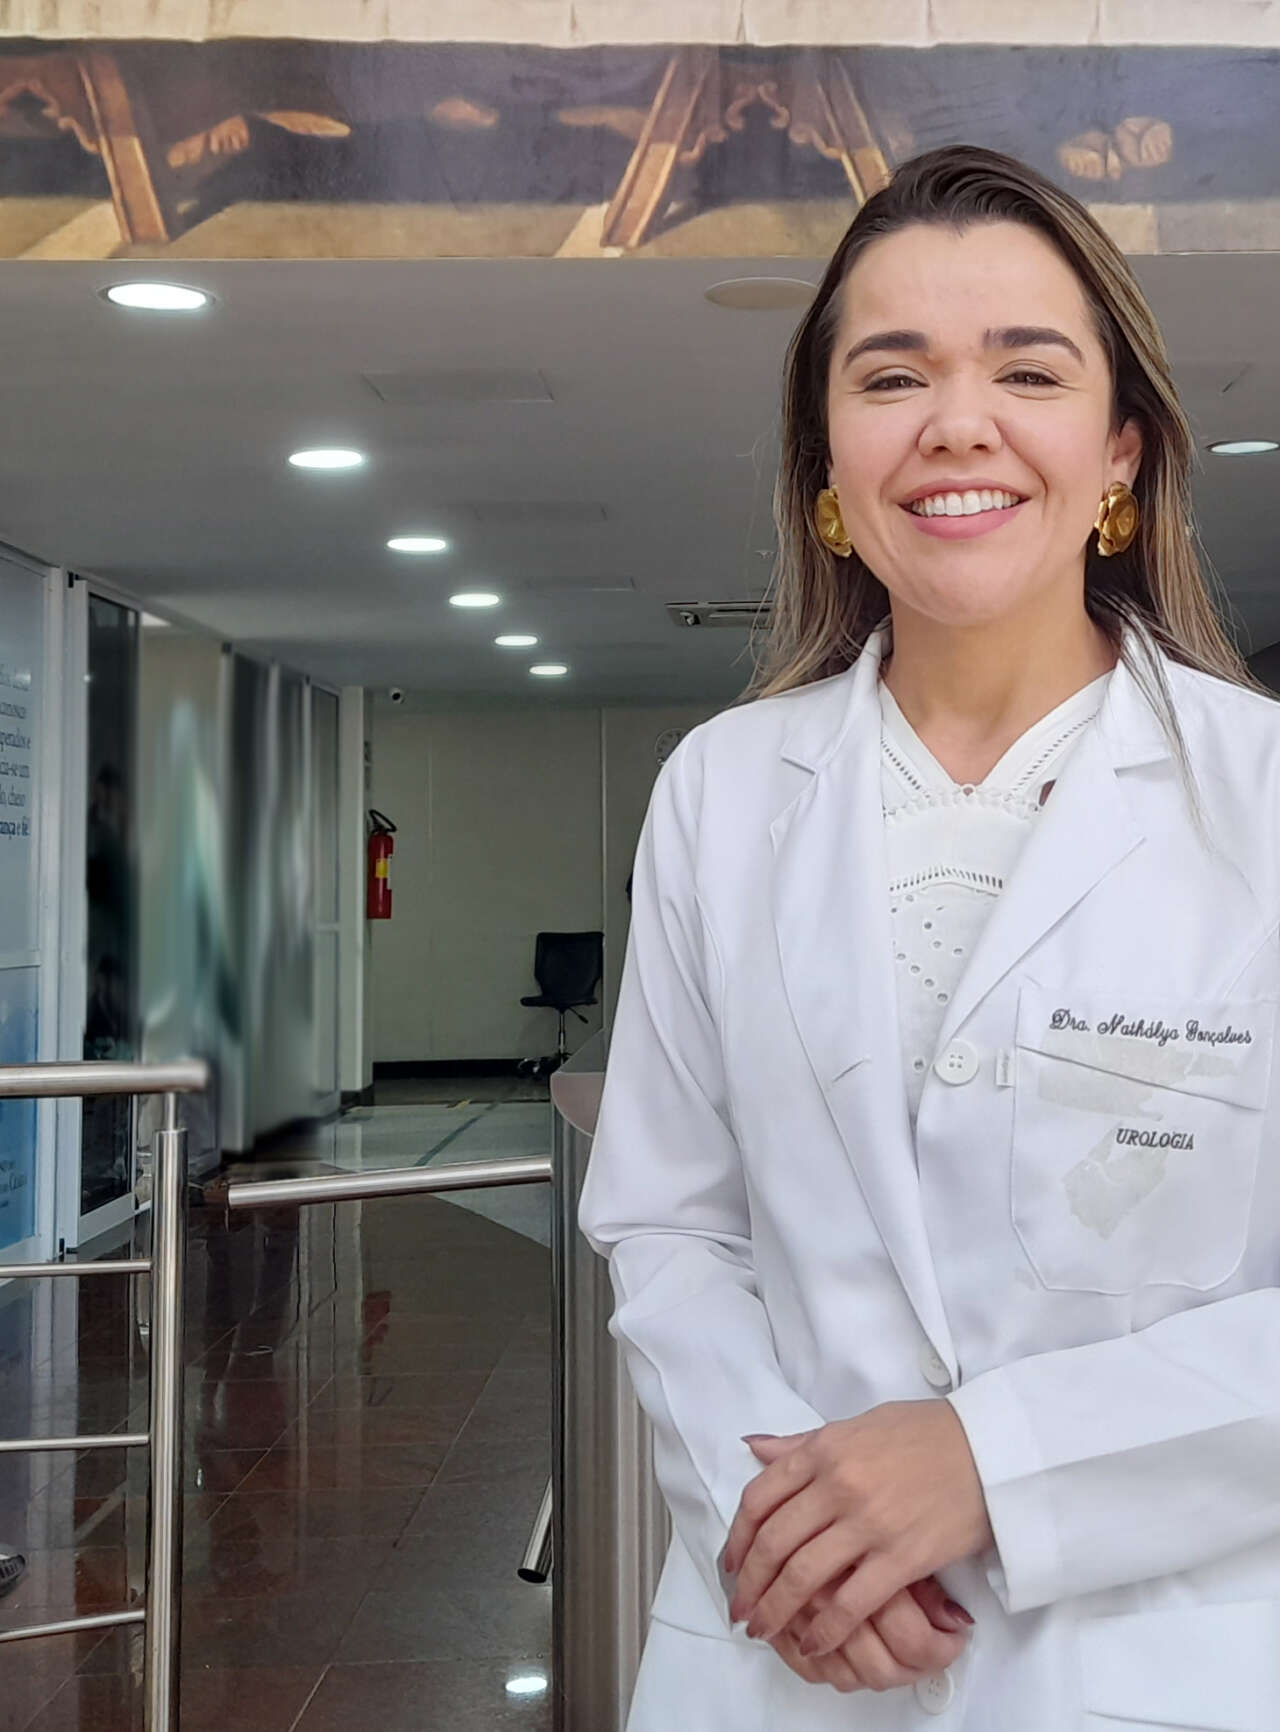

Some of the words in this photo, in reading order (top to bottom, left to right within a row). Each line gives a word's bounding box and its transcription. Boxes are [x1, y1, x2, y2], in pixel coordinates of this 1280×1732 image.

[1049, 1008, 1091, 1031] Dra.
[1185, 1019, 1252, 1047] Gonçalves
[1116, 1128, 1194, 1150] UROLOGIA
